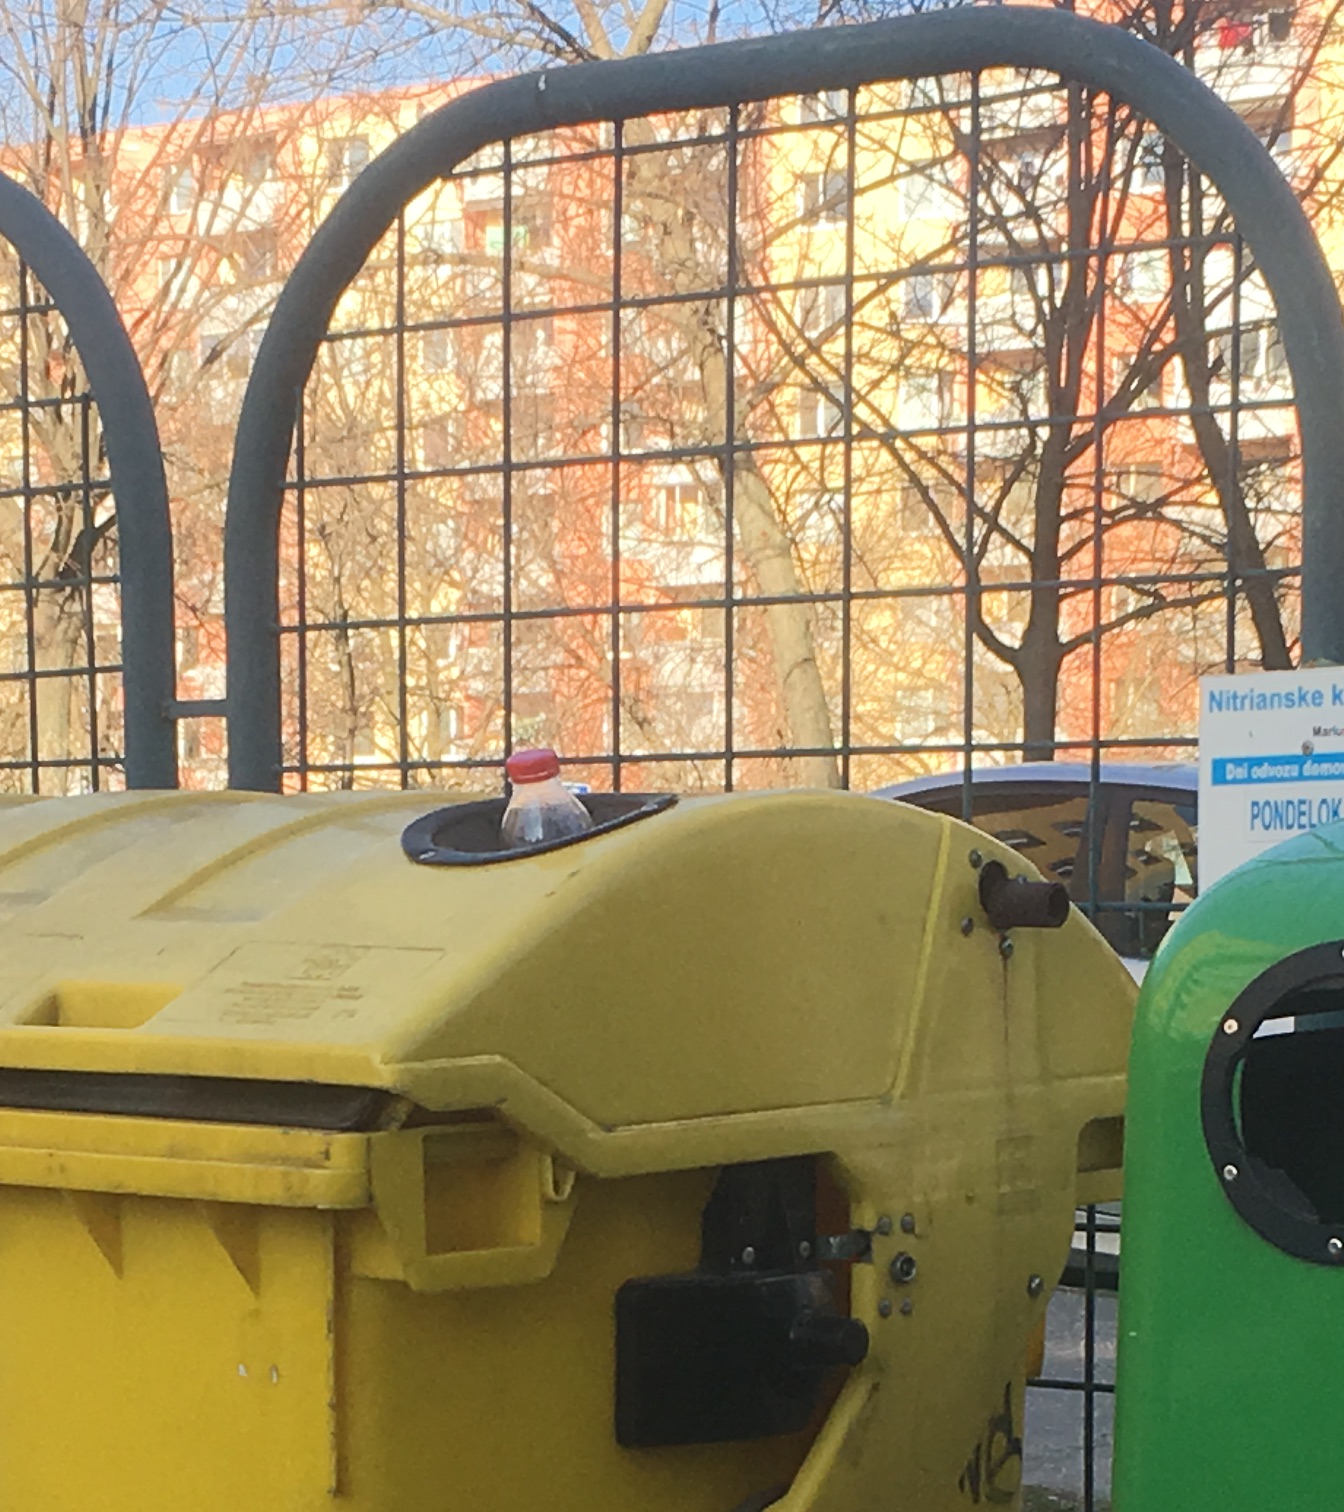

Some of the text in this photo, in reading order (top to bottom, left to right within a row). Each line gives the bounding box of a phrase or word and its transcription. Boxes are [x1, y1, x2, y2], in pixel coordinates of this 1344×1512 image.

[1208, 684, 1324, 713] Nitrianske
[1251, 761, 1299, 779] odvozu
[1249, 797, 1343, 831] PONDELOK
